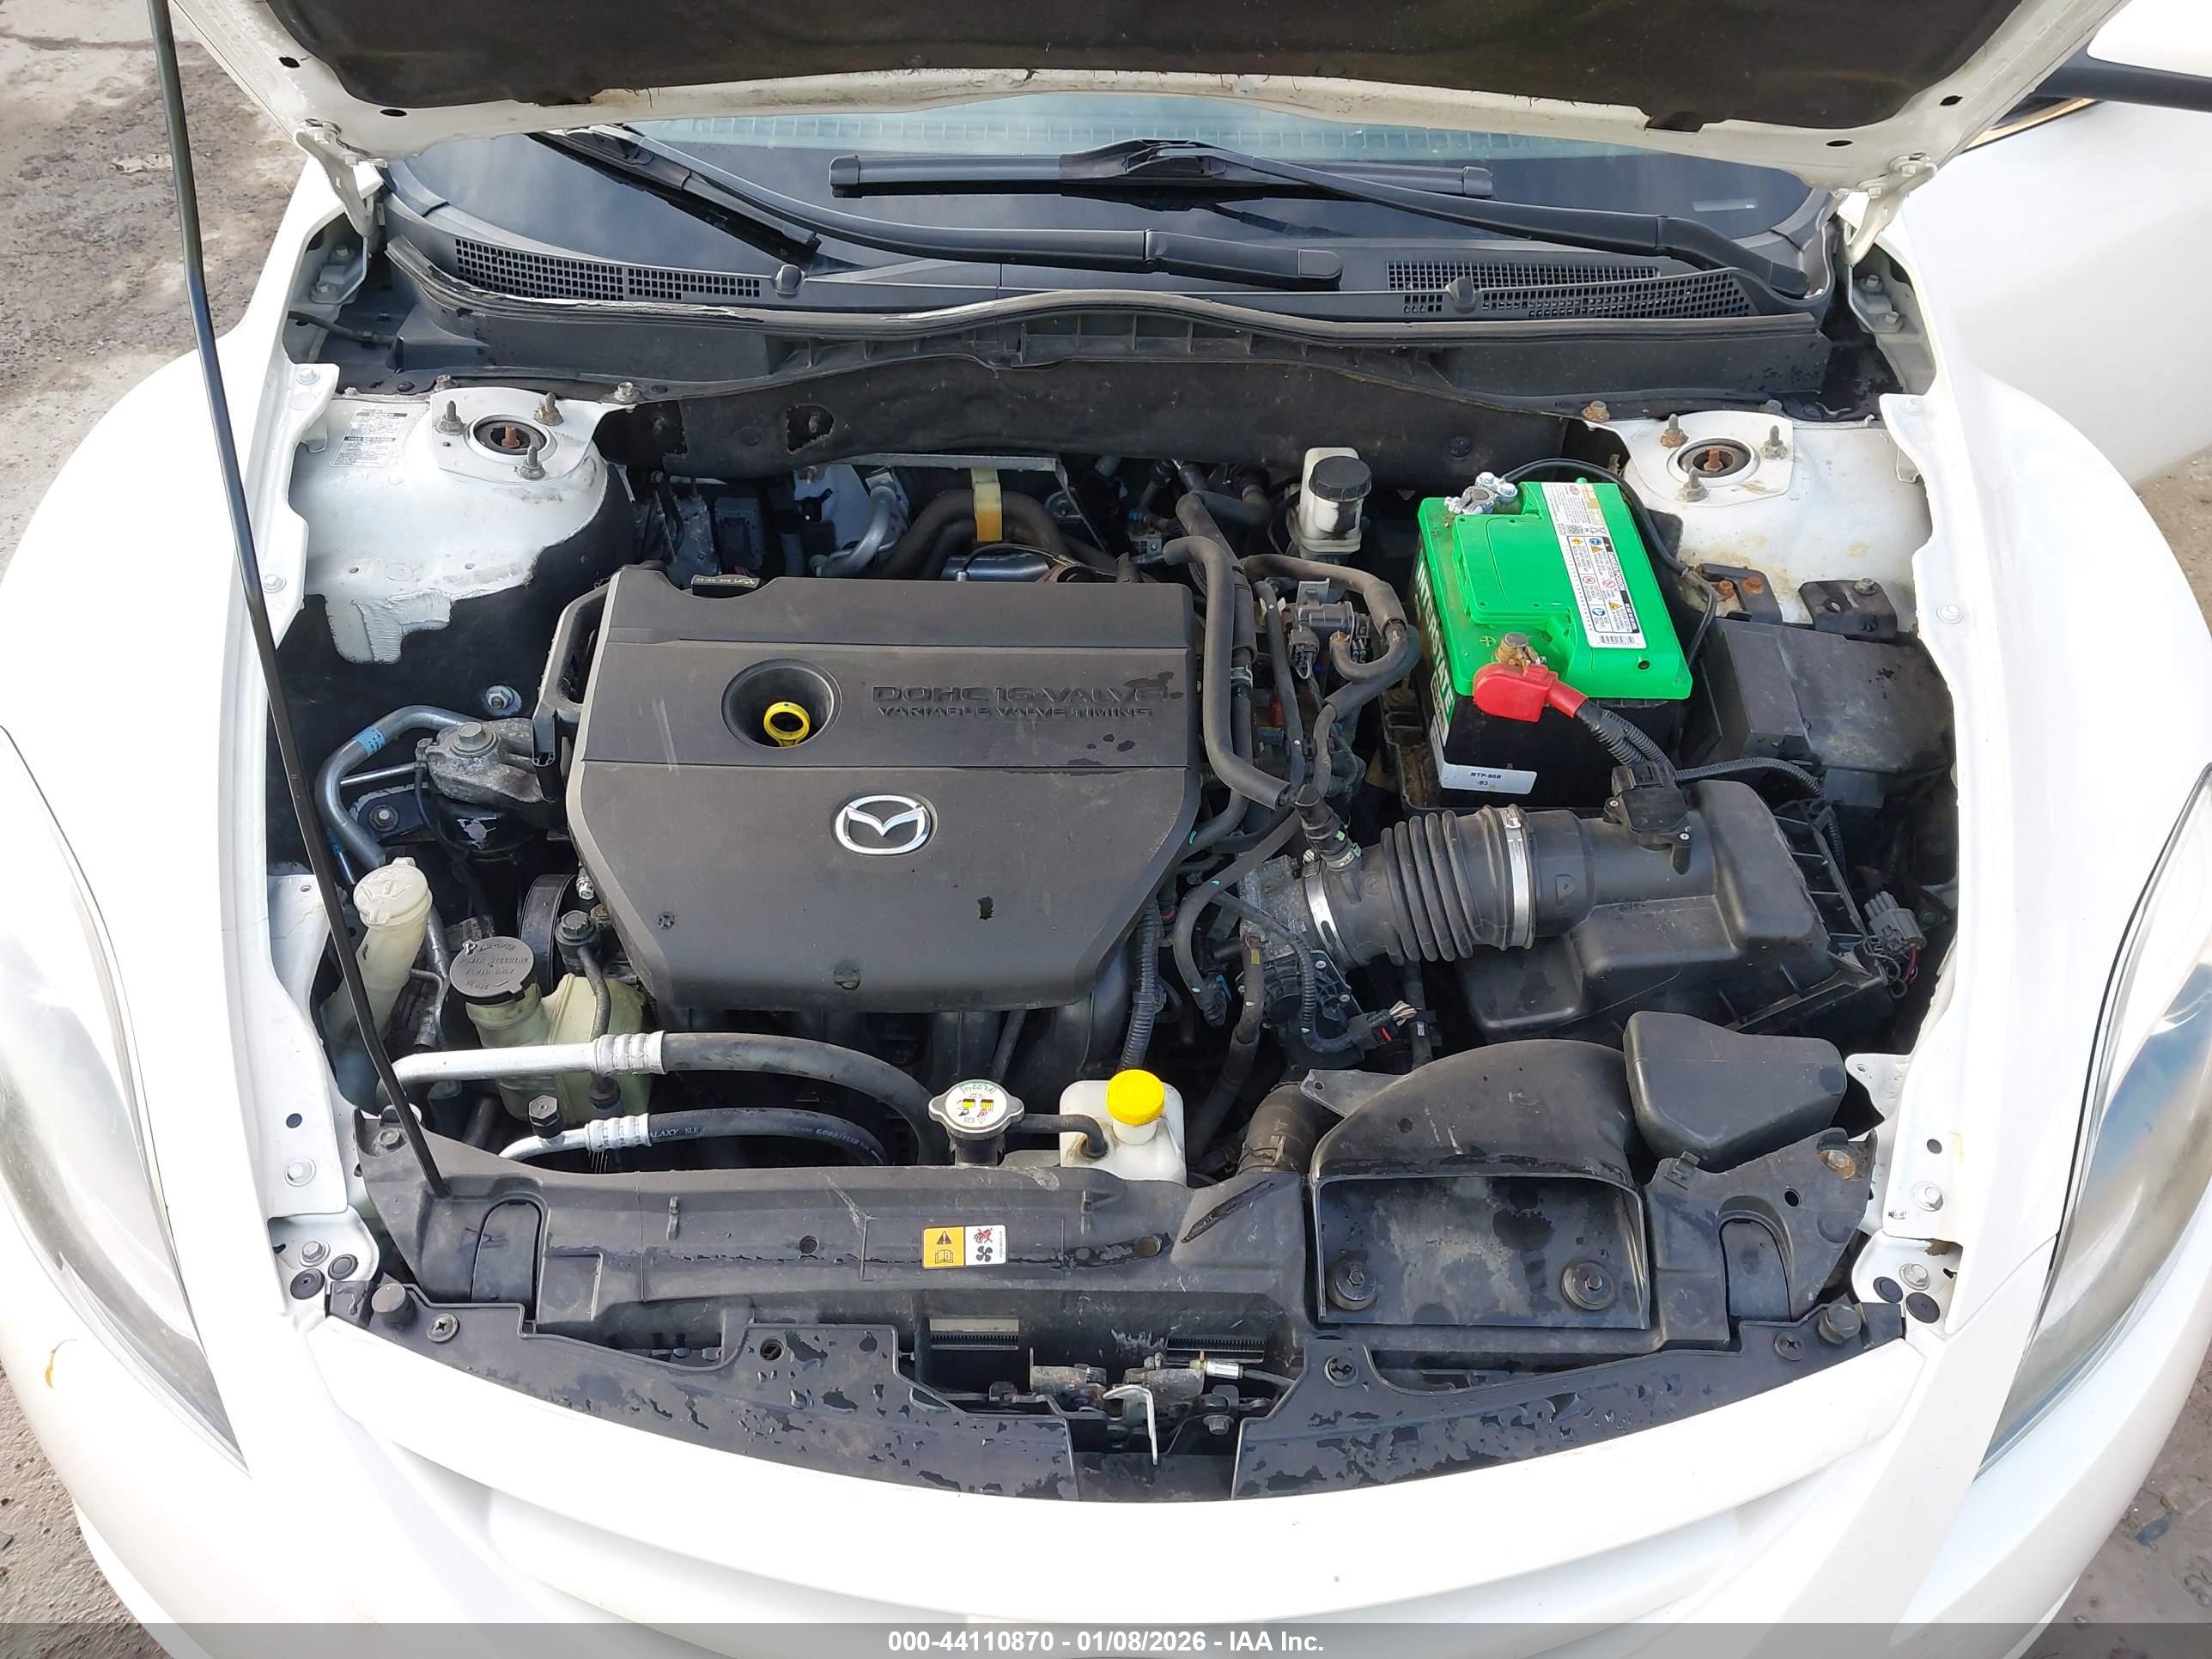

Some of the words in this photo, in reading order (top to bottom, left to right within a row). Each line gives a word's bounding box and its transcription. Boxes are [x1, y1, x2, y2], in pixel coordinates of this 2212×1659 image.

[1417, 560, 1455, 714] INTERSTATE
[871, 686, 988, 702] DOHC
[994, 686, 1155, 702] 16-VALVE
[878, 707, 989, 717] VARIABLE
[995, 707, 1066, 717] VALVE
[1071, 707, 1153, 717] TIMING
[972, 1084, 994, 1092] FL22
